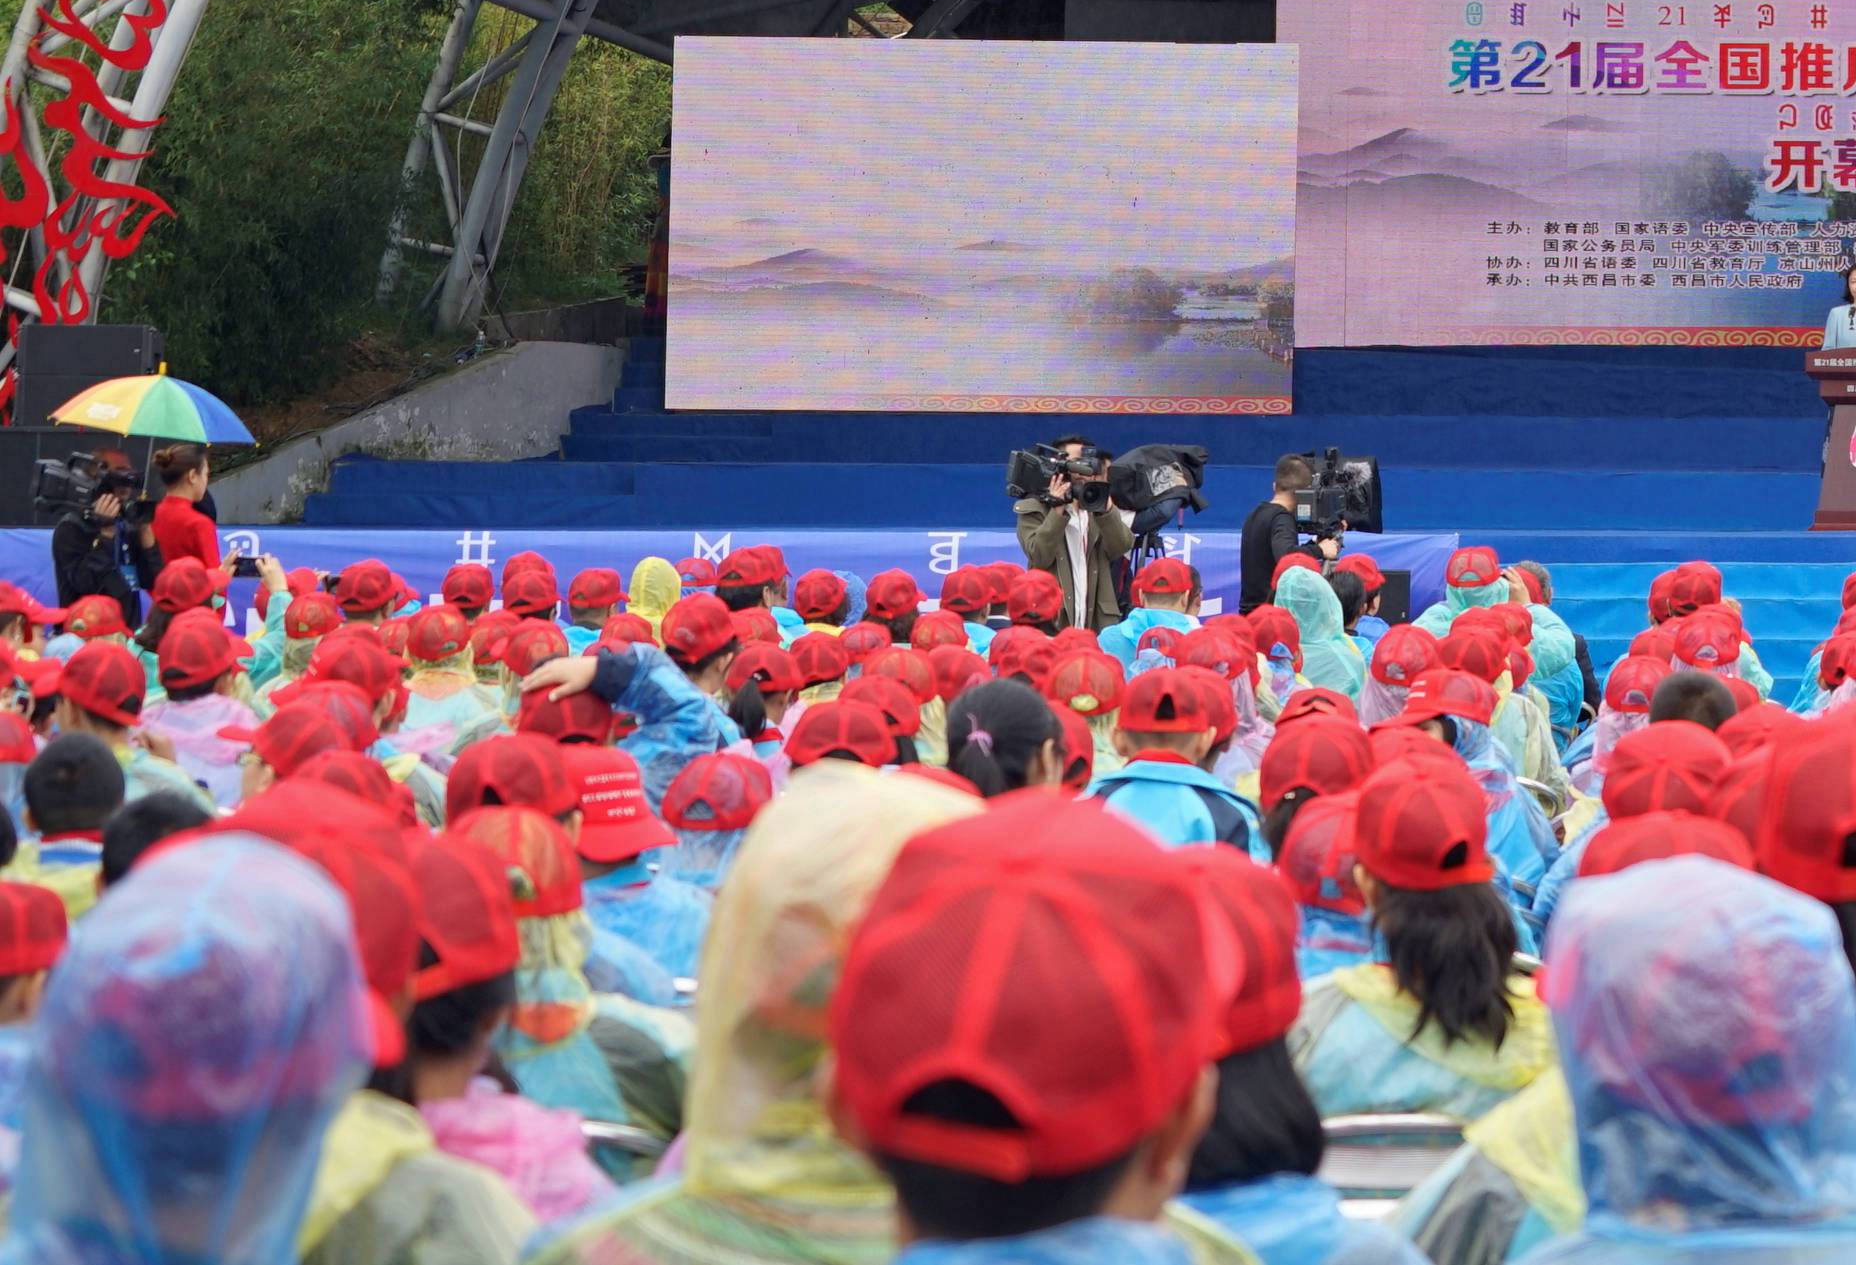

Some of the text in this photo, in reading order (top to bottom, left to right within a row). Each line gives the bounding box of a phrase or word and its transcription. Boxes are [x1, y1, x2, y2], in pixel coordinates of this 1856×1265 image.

[1544, 222, 1600, 237] 教育部
[1614, 222, 1690, 237] 国家语委
[1702, 223, 1799, 238] 中央宣传部
[1543, 239, 1656, 253] 国家公务员局
[1671, 239, 1842, 254] 中央军委训练管理部
[1544, 256, 1638, 270] 四川省语委
[1652, 256, 1764, 271] 四川省教育厅
[1544, 274, 1656, 288] 中共西昌市委
[1672, 274, 1804, 289] 西昌市人民政府
